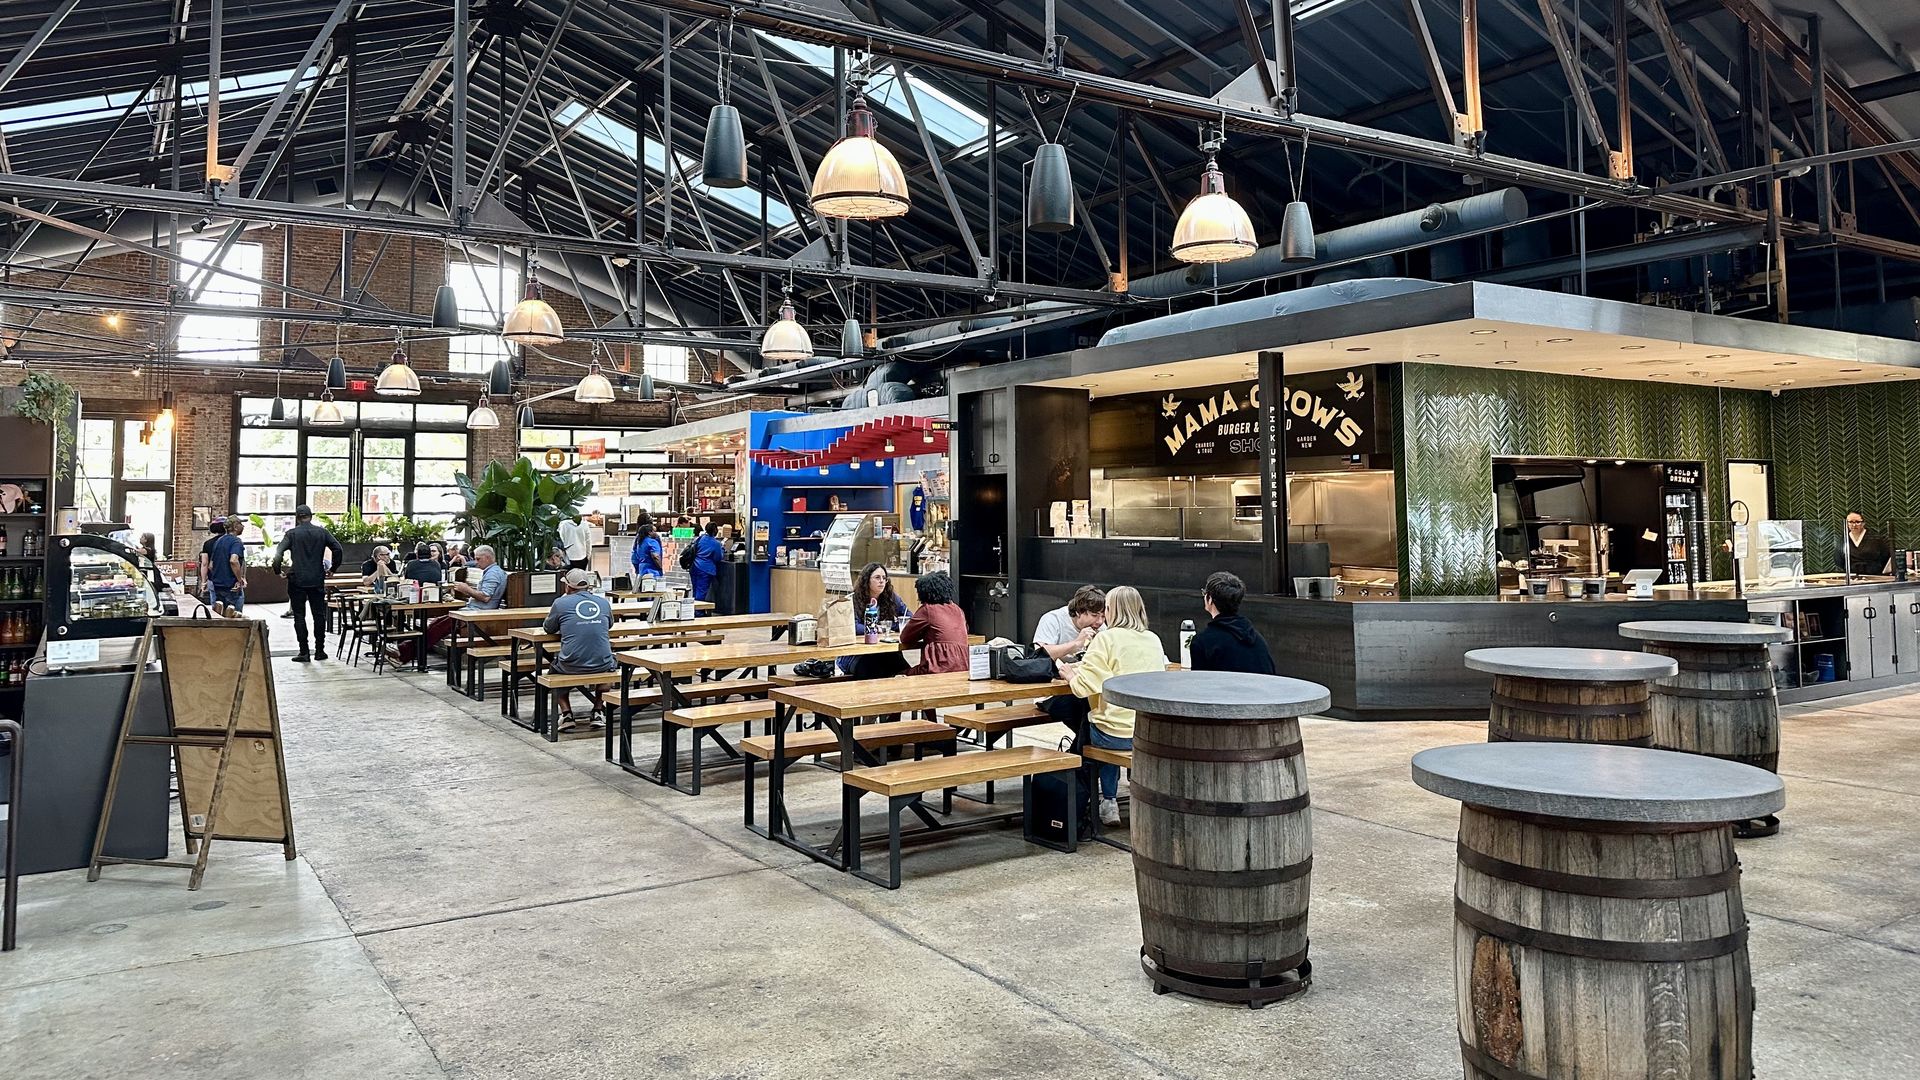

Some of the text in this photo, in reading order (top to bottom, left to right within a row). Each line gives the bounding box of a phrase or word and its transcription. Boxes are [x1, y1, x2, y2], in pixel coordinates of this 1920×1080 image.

[931, 422, 951, 430] WATER
[1164, 389, 1239, 457] MAMA
[1217, 422, 1251, 436] BURGER
[1270, 448, 1277, 465] UP
[1674, 469, 1691, 477] COLD
[1670, 475, 1695, 484] DRINKS
